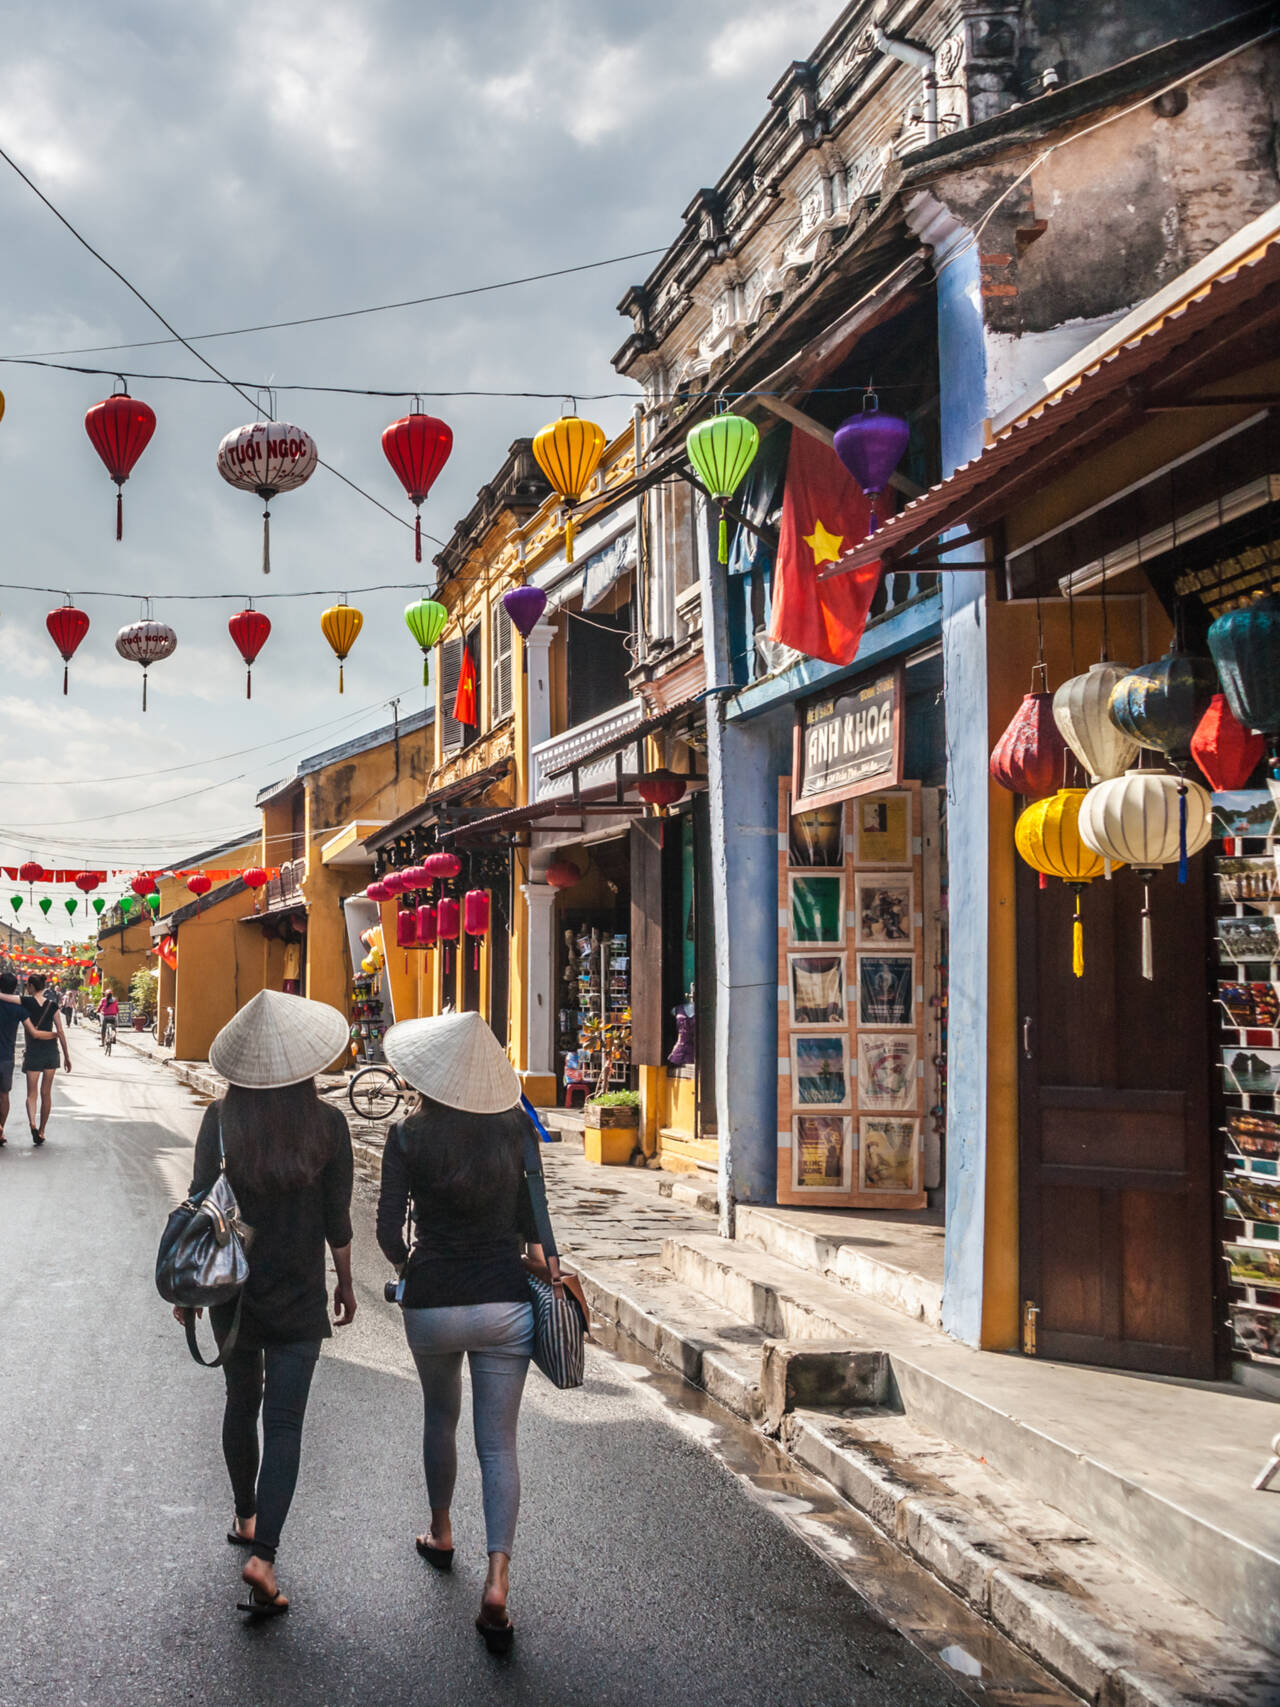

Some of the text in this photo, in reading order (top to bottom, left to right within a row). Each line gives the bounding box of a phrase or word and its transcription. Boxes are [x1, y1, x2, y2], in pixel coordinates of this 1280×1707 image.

[266, 438, 307, 463] NGỌC
[808, 700, 891, 769] ANH KHOA
